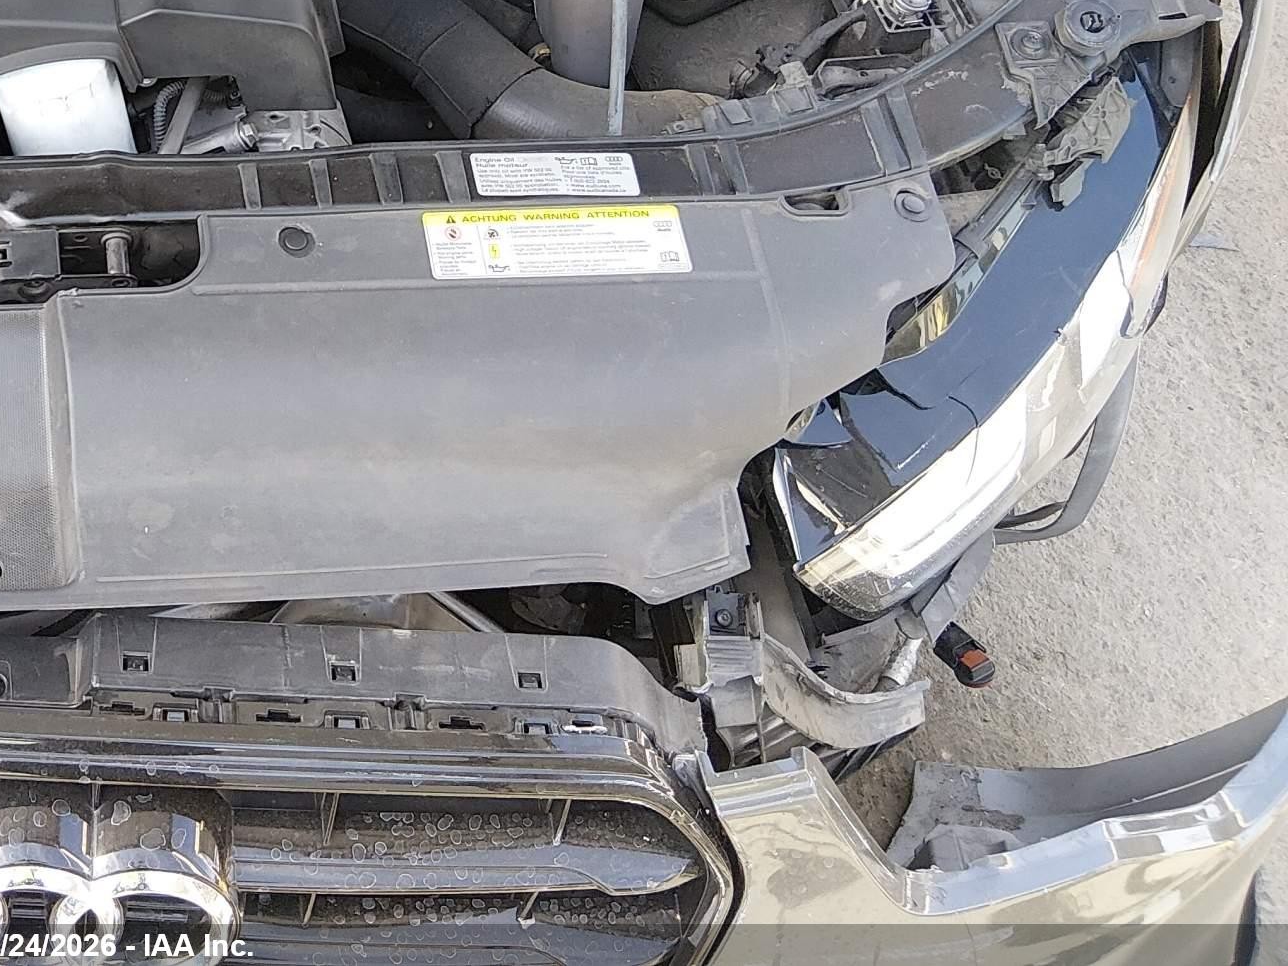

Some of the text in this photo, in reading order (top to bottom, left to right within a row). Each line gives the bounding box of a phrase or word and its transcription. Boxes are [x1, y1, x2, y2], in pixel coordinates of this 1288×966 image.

[462, 210, 649, 223] ACHTUNG WARNING ATTENTION
